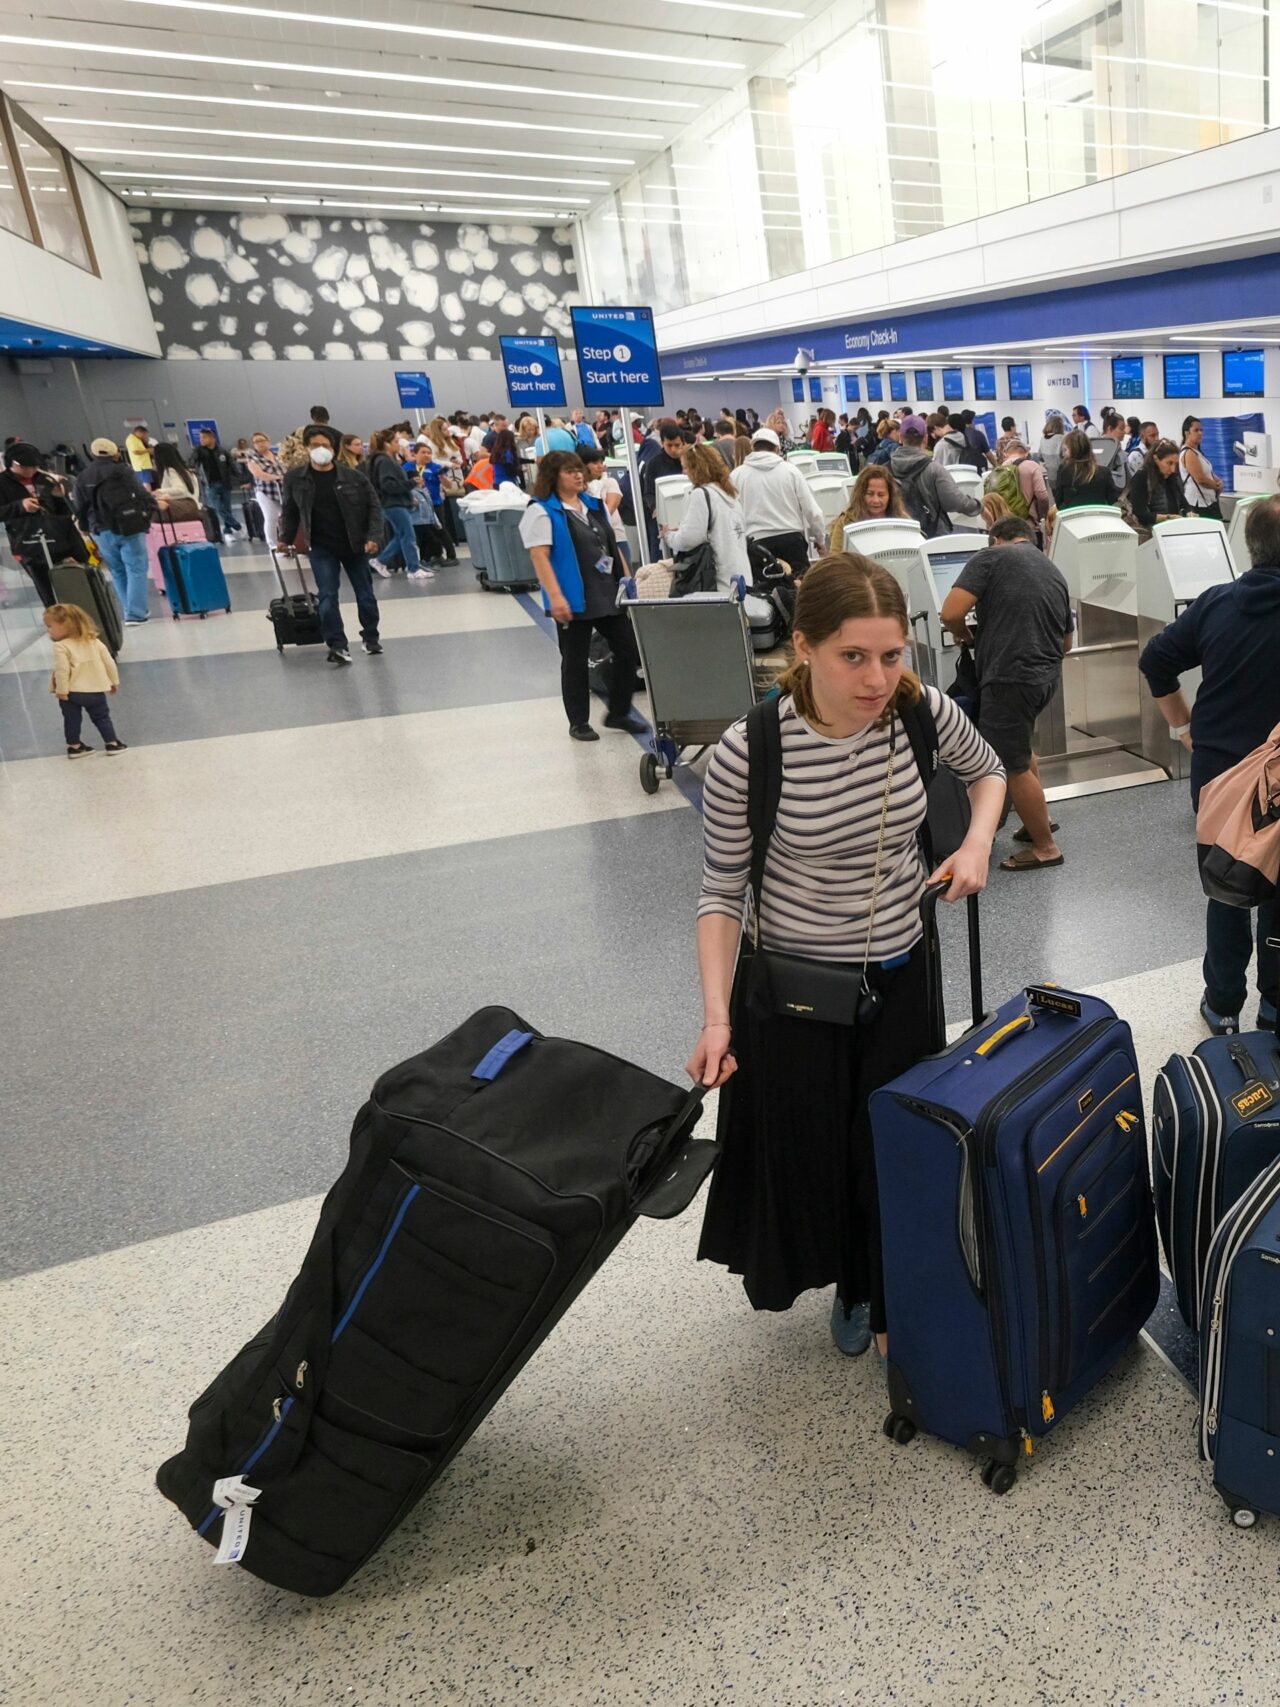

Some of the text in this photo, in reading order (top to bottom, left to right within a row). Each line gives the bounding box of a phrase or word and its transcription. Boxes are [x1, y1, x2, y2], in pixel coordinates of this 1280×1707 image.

[592, 312, 625, 320] UNITED
[845, 328, 898, 351] Economy Check-In
[583, 347, 612, 362] Step
[508, 364, 529, 375] Step
[586, 371, 649, 383] Start here
[1047, 378, 1072, 387] UNITED
[511, 381, 556, 391] Start here
[1041, 995, 1074, 1012] Lucas
[1237, 1087, 1268, 1111] Lucas
[235, 1509, 246, 1548] UNITED
